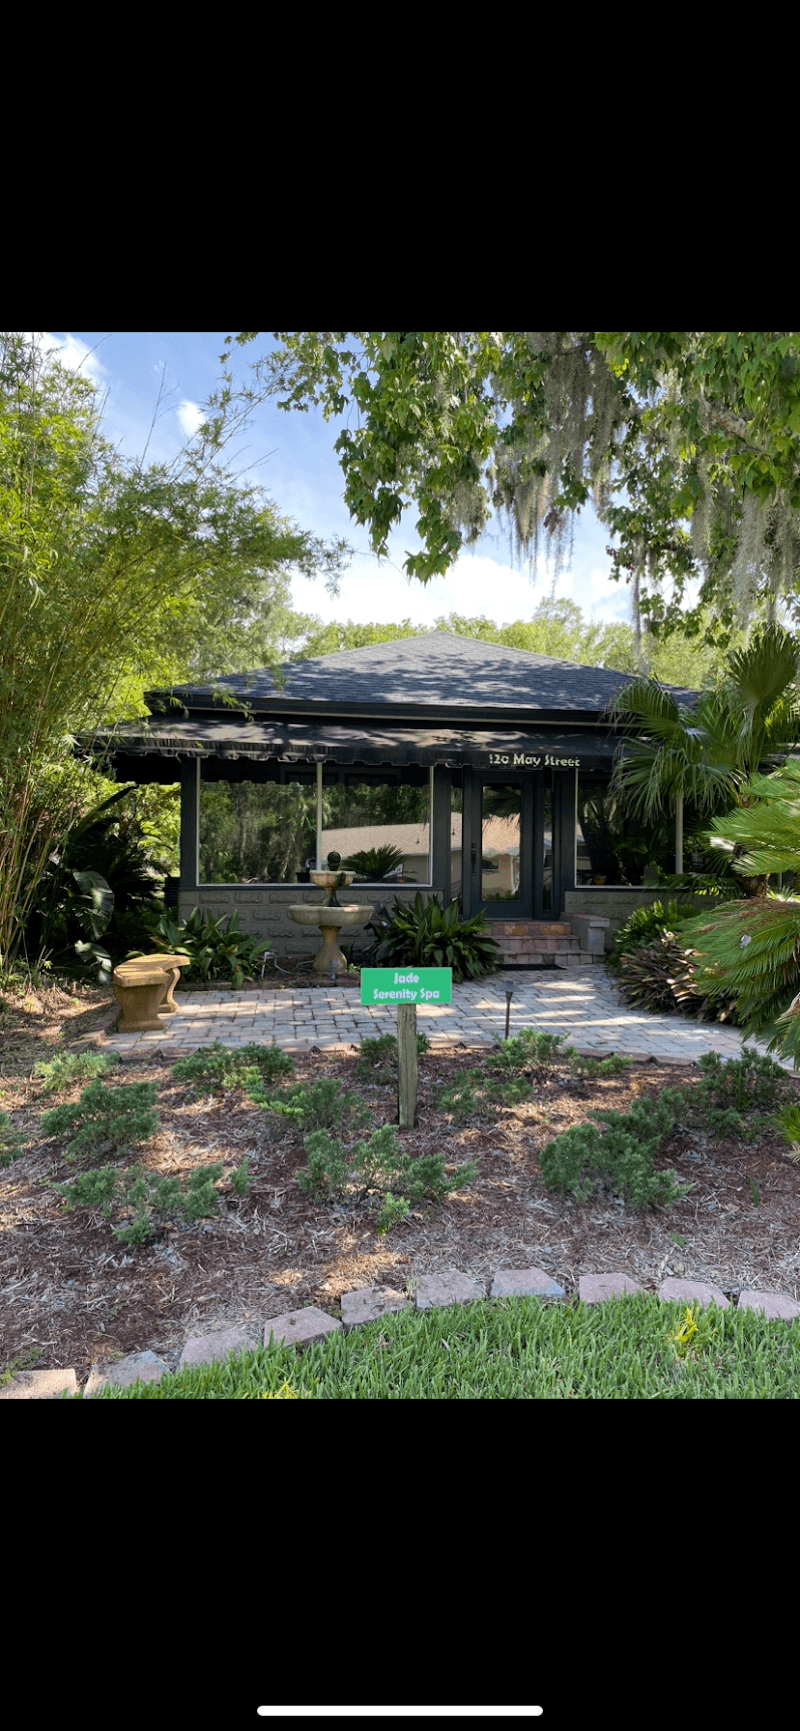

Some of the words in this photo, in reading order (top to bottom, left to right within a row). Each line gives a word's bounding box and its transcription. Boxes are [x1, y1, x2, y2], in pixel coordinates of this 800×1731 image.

[513, 753, 541, 767] May
[544, 754, 581, 767] Street
[393, 972, 420, 985] Jade
[373, 988, 417, 1001] Serenity
[419, 987, 440, 1001] Spa
